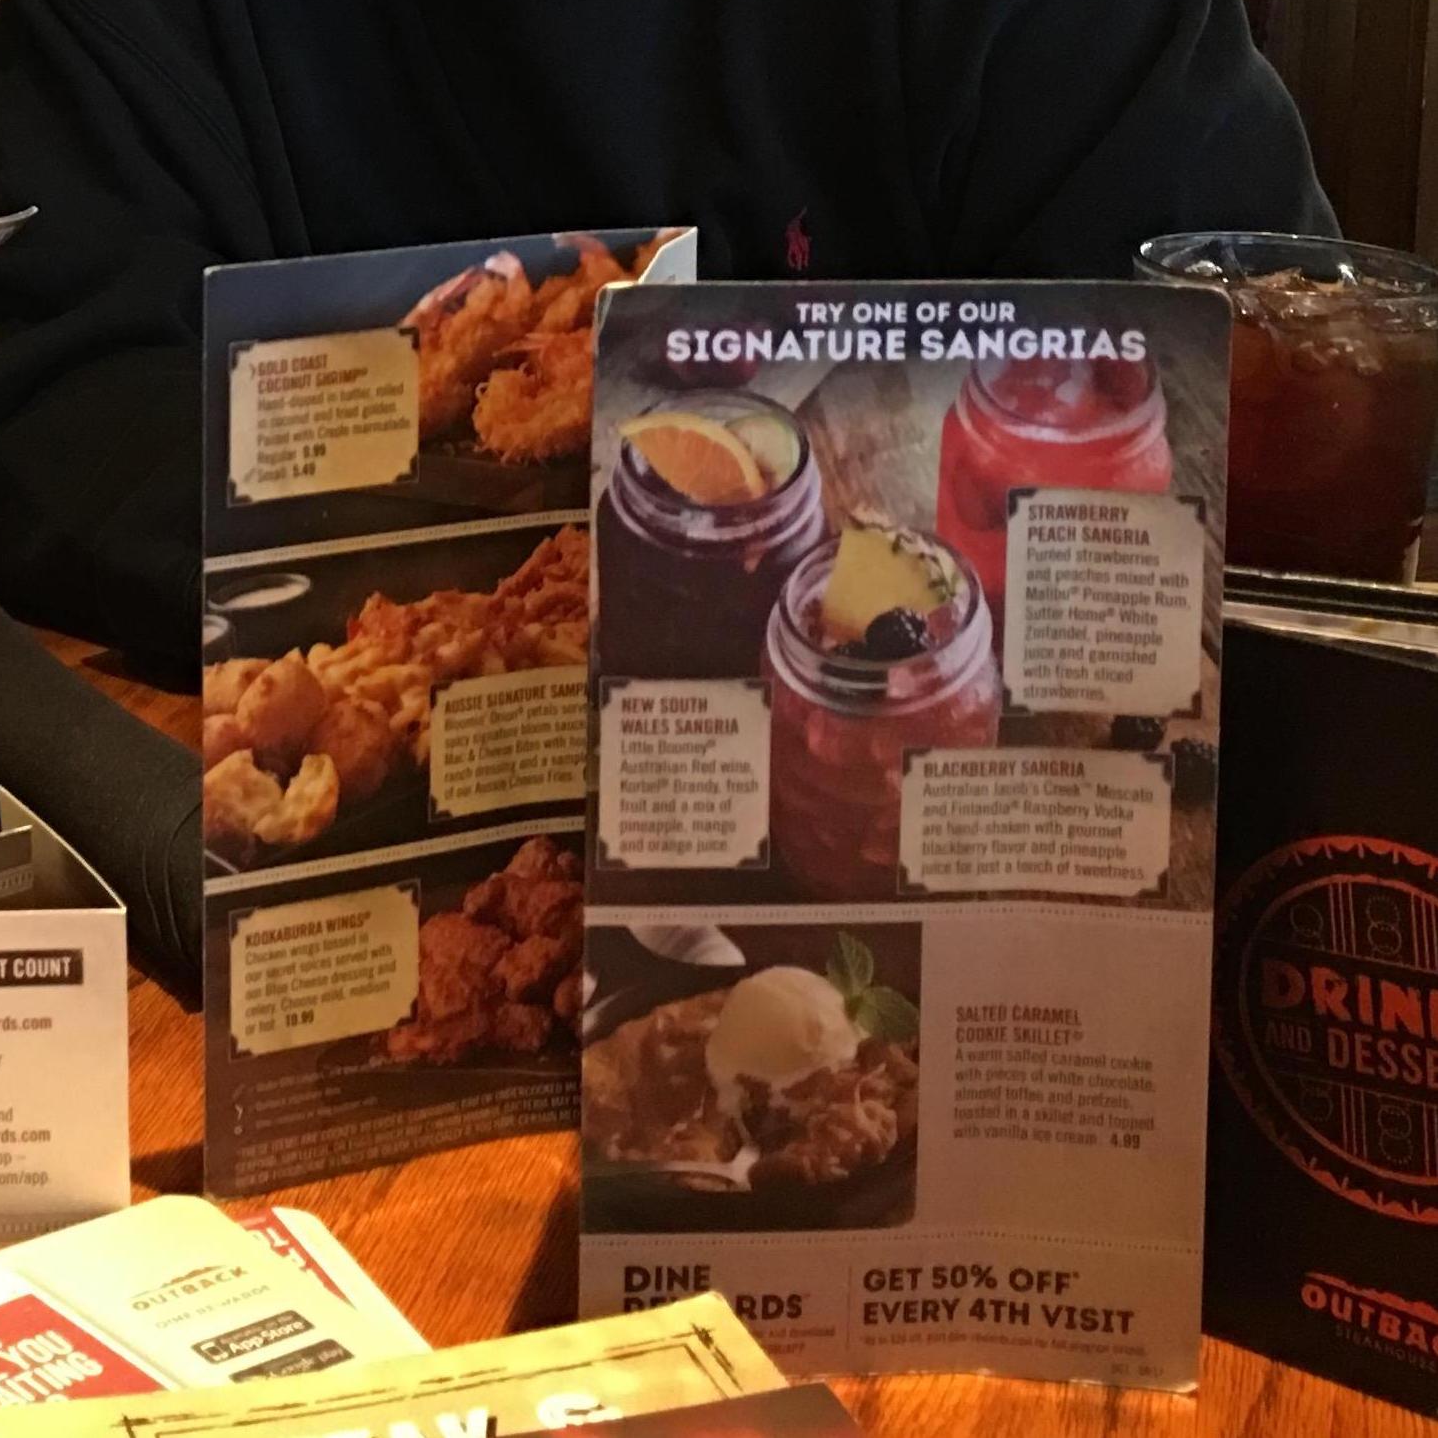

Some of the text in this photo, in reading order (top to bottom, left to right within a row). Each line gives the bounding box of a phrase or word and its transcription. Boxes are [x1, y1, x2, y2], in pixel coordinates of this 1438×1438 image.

[797, 303, 1014, 323] TRY ONE OF OUR
[667, 329, 1146, 362] SIGNATURE SANGRIAS
[258, 354, 327, 376] GOLD COAST
[1028, 504, 1129, 522] STRAWBERRY
[1028, 526, 1150, 545] PEACH SANGRIA
[445, 693, 482, 714] AUSSIE
[487, 686, 545, 706] SIGNATURE
[622, 698, 707, 713] NEW SOUTH
[621, 718, 738, 735] WALES SANGRIA
[924, 760, 1085, 777] BLACKBERRY SANGRIA
[246, 923, 323, 947] KOOKABURRA
[13, 956, 70, 979] COUNT
[956, 1005, 1081, 1025] SALTED CARAMEL
[956, 1026, 1007, 1043] COOKIE
[132, 1266, 248, 1310] OUTBACK
[624, 1265, 710, 1292] DINE
[863, 1268, 922, 1293] GET
[932, 1266, 997, 1290] 50%
[864, 1299, 1133, 1335] EVERY 4TH VISIT
[1301, 1284, 1438, 1355] OUTBA
[228, 1338, 264, 1353] App
[261, 1321, 305, 1340] Store
